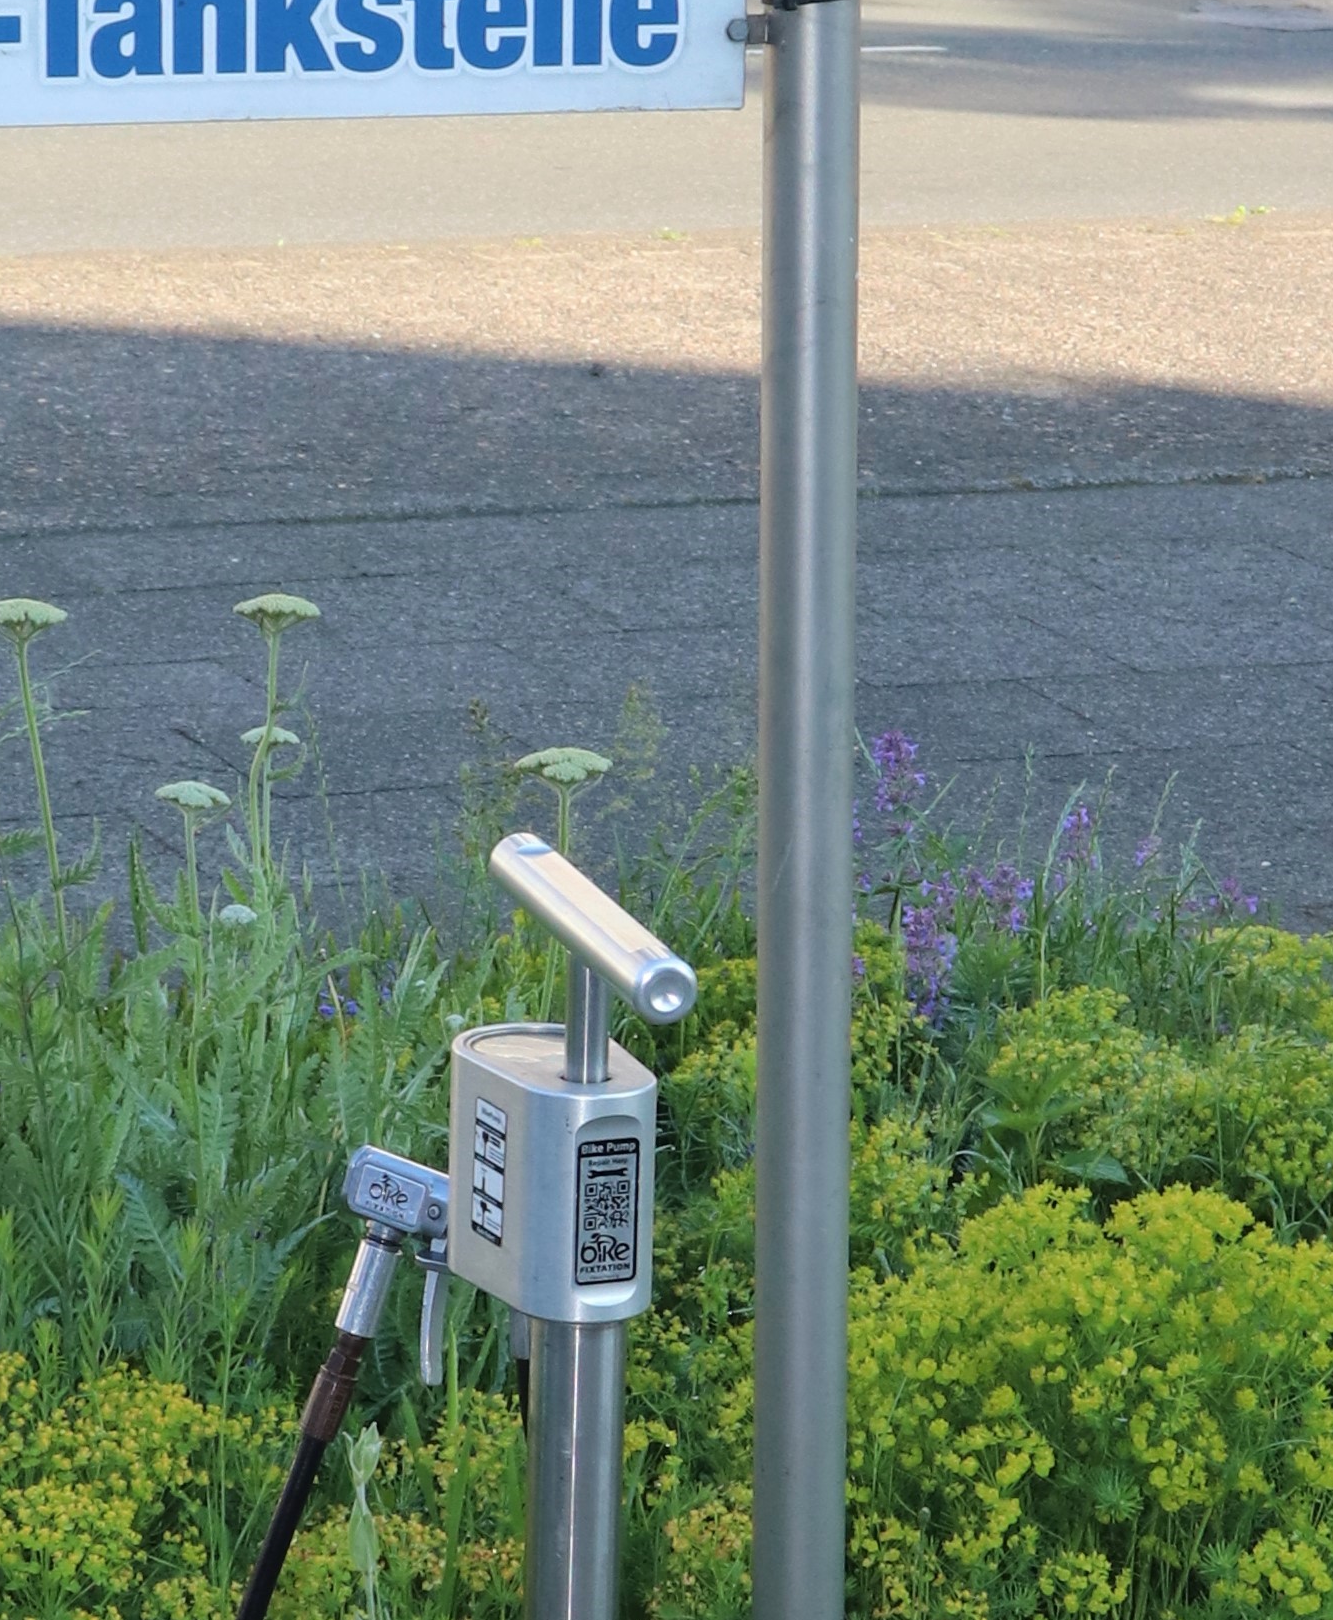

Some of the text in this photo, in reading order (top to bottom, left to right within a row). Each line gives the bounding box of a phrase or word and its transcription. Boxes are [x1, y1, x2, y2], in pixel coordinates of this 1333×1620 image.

[581, 1141, 636, 1155] Bike Pump
[580, 1261, 630, 1274] FIXTATION
